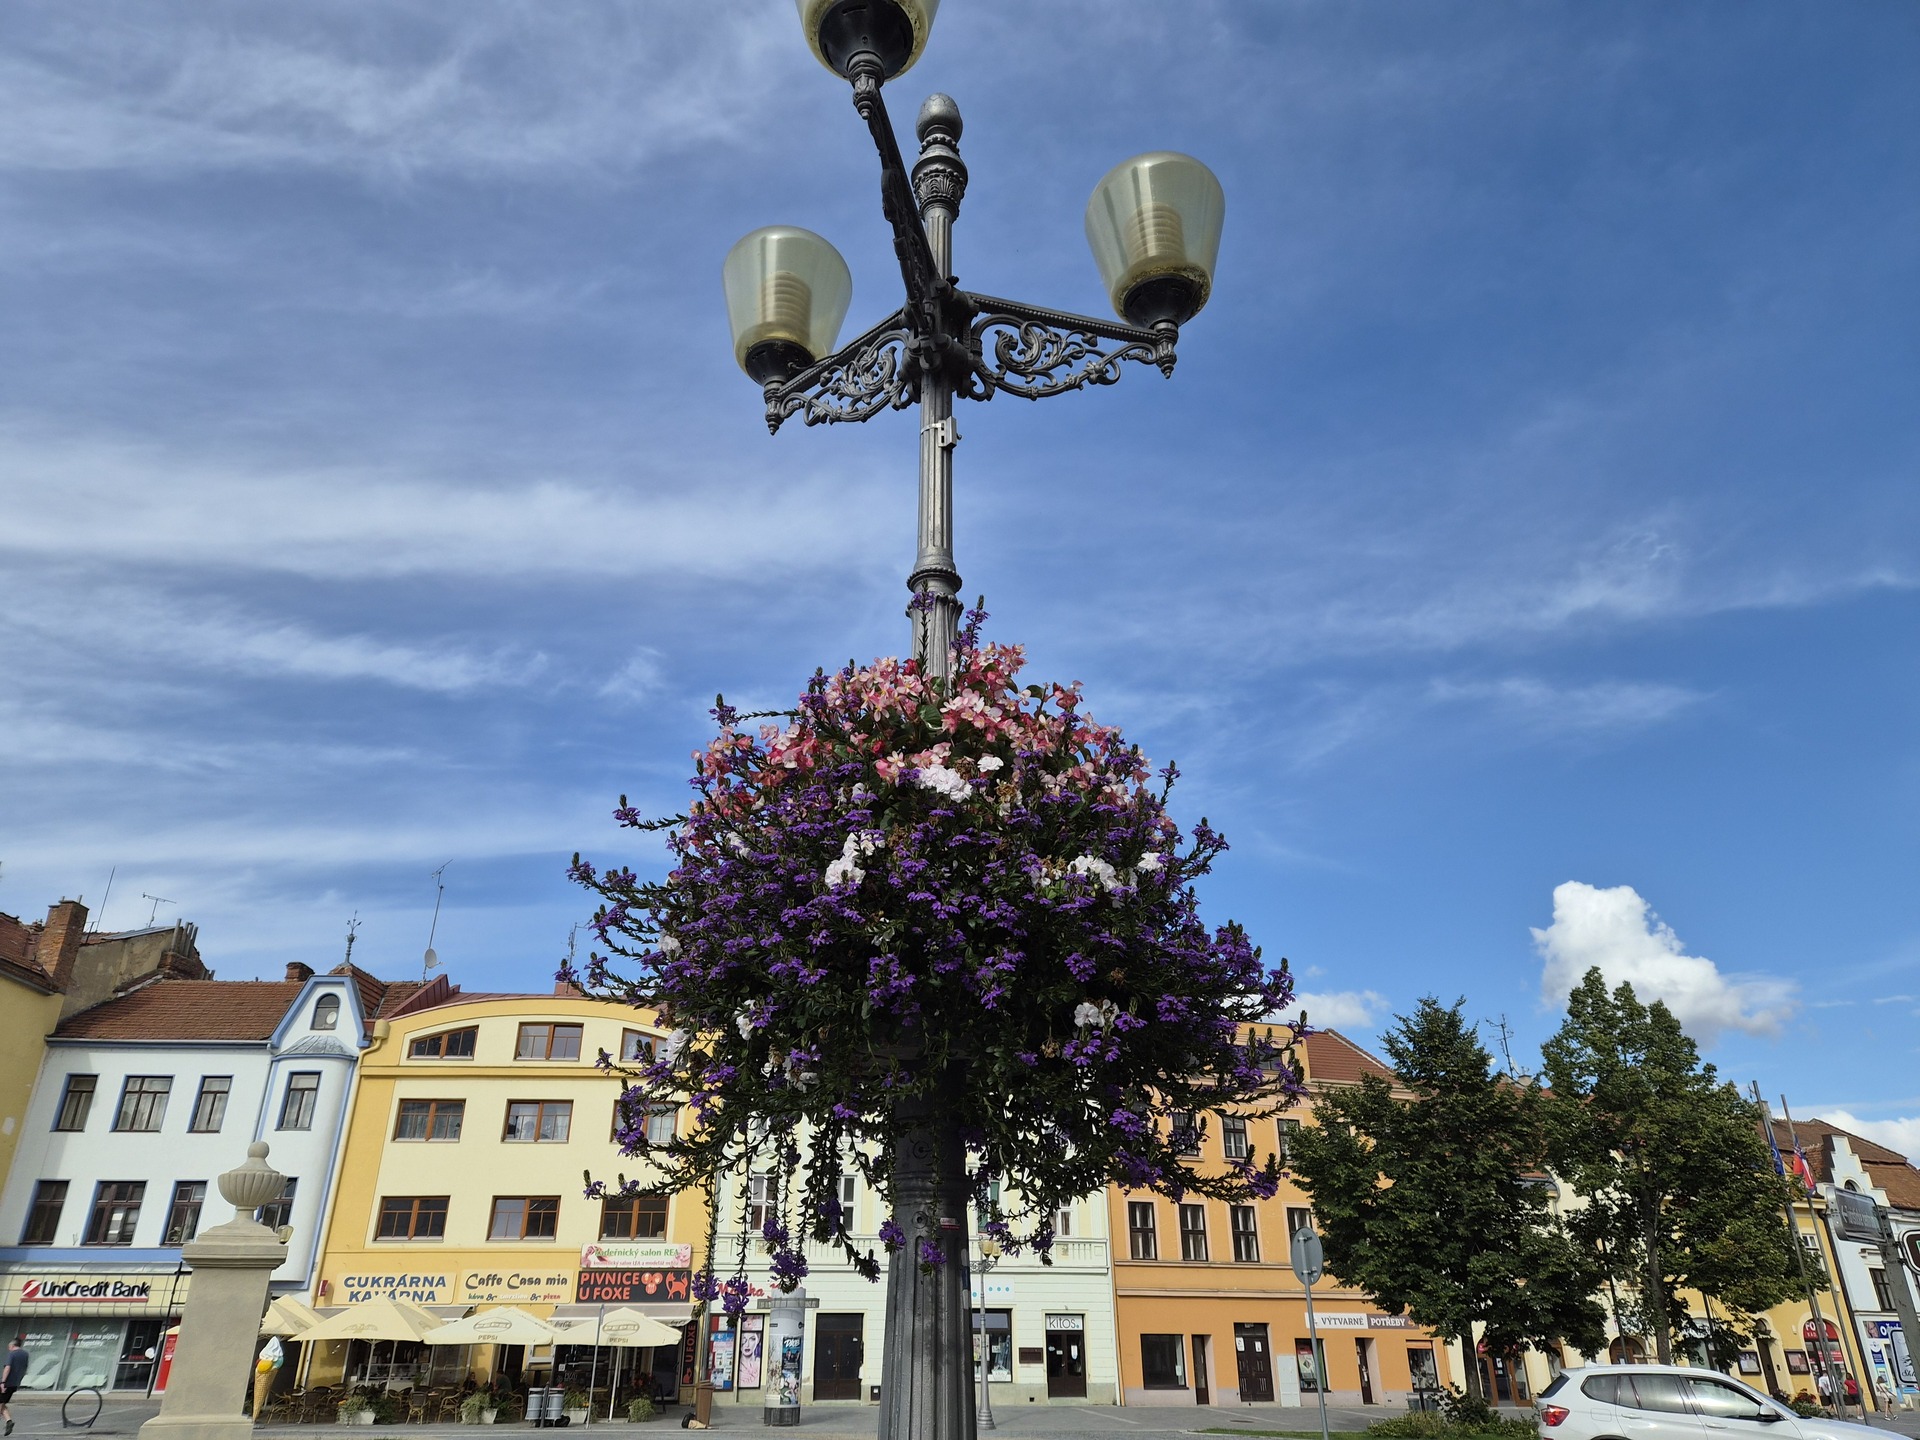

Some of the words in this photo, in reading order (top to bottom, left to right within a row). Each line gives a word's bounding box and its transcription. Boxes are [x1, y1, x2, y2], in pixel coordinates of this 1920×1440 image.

[641, 1248, 662, 1256] salon
[343, 1274, 447, 1288] CUKRÁRNA
[465, 1273, 503, 1289] Caffe
[507, 1273, 541, 1289] Casa
[545, 1274, 568, 1286] mia
[580, 1272, 640, 1285] PIVNICE
[41, 1281, 110, 1297] UniCredit
[111, 1281, 151, 1297] Bank
[579, 1287, 590, 1300] U
[593, 1287, 631, 1300] FOXE
[1321, 1316, 1364, 1326] VÝTVARNÉ
[1370, 1316, 1406, 1327] POTŘEBY
[686, 1324, 696, 1352] FOXE
